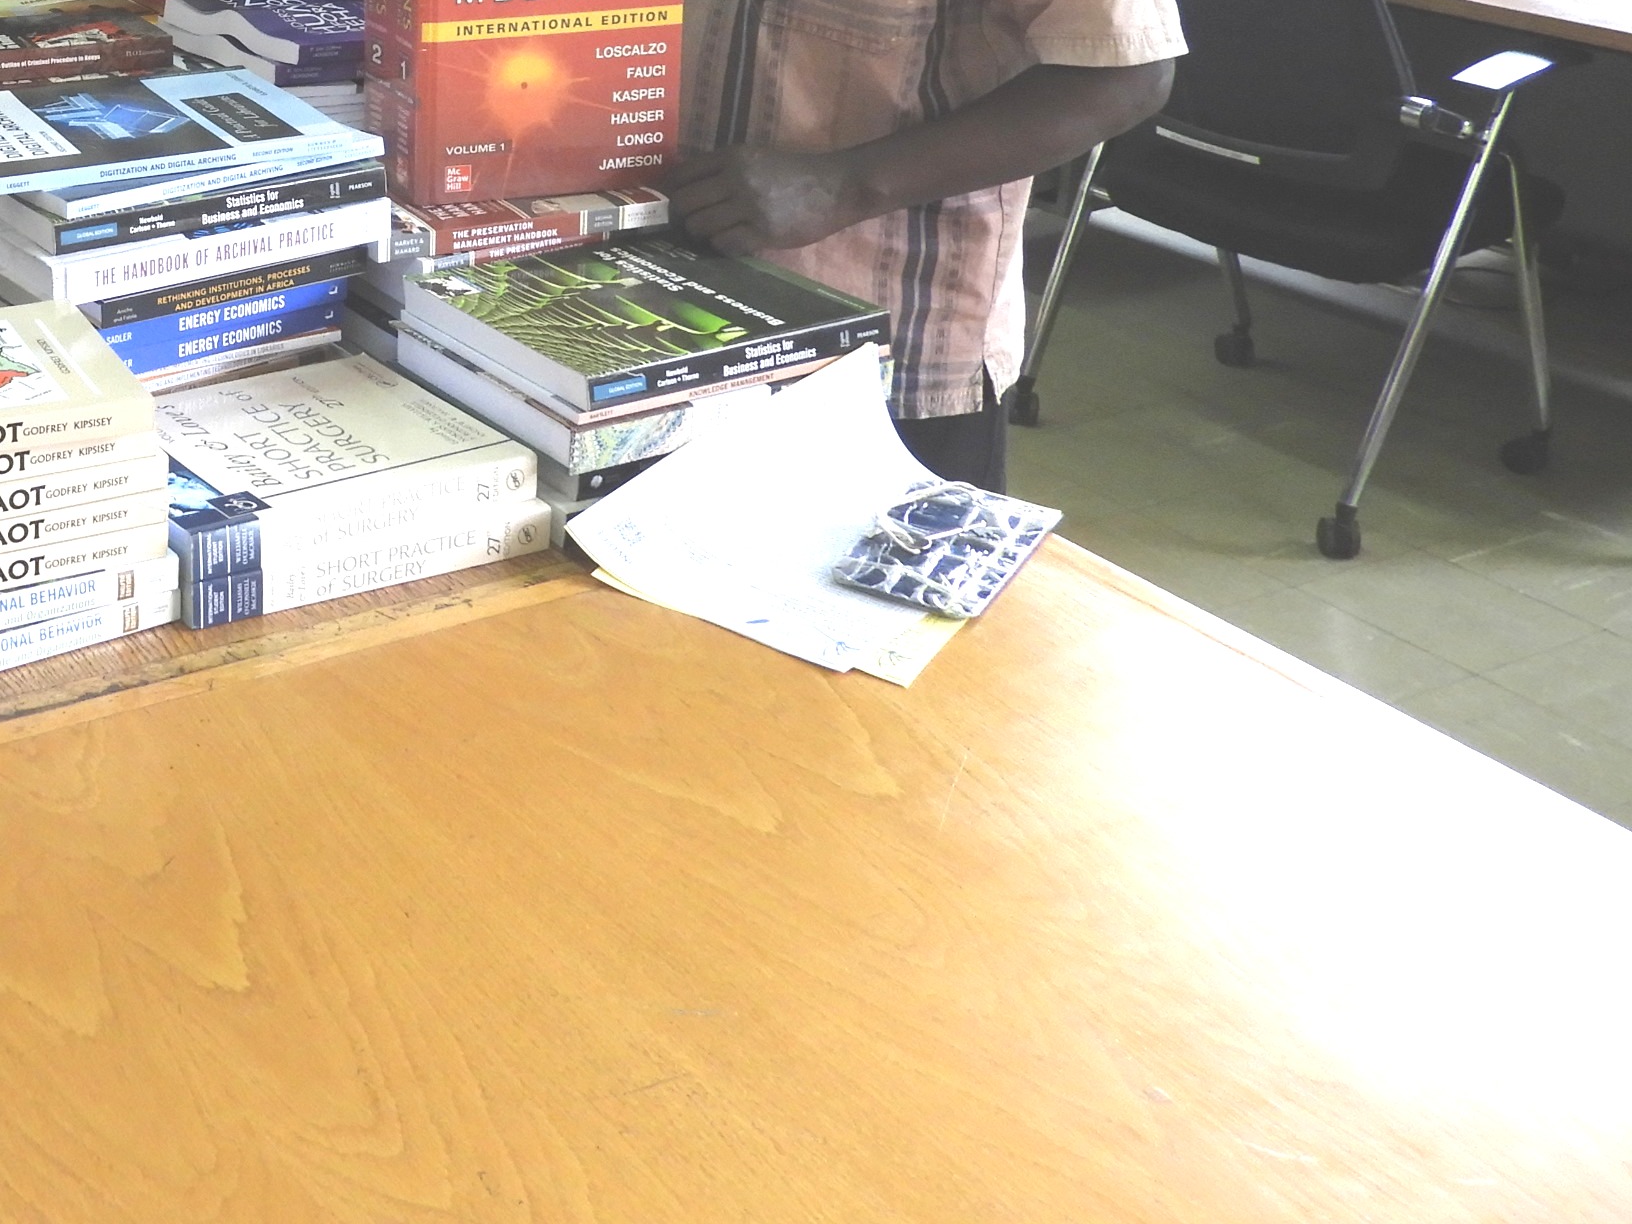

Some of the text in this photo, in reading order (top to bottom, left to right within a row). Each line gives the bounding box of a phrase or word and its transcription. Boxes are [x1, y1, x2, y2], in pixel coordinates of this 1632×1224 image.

[457, 10, 668, 36] INTERNATIONAL EDITION
[372, 44, 382, 64] 2
[596, 42, 667, 58] LOSCALZO
[1, 60, 20, 69] Outline
[28, 58, 50, 67] Criminal
[51, 56, 77, 65] Procedure
[84, 54, 100, 62] Kenya
[400, 61, 406, 79] 1
[627, 65, 666, 79] FAUCI
[612, 87, 665, 102] KASPER
[611, 110, 664, 125] HAUSER
[16, 132, 49, 155] DIGITAL
[446, 142, 505, 155] VOLUME 1
[617, 132, 664, 147] LONGO
[6, 181, 30, 189] LEGGETT
[100, 165, 148, 177] DIGITIZATION
[168, 160, 195, 168] DIGITAL
[198, 154, 236, 165] ARCHIVING
[253, 149, 272, 157] SECOND
[274, 147, 293, 155] EDITION
[447, 167, 462, 176] Mc
[599, 154, 663, 171] JAMESON
[163, 182, 205, 195] DIGITIZATION
[208, 177, 221, 186] AND
[223, 172, 246, 184] DIGITAL
[250, 164, 283, 178] ARCHIVING
[349, 182, 372, 191] PEARSON
[446, 174, 469, 184] Graw
[446, 182, 462, 191] Hill
[226, 189, 279, 208] Statistics for
[202, 198, 304, 225] Business and Economics
[453, 221, 533, 238] THE PRESERVATION
[453, 228, 558, 249] MANAGEMENT HANDBOOK
[95, 223, 334, 286] THE HANDBOOK OF ARCHIVAL PRACTICE
[489, 238, 562, 258] THE PRESERVATION
[593, 251, 616, 261] for
[609, 247, 687, 282] Economics
[615, 259, 684, 292] Statistics
[157, 286, 207, 305] RETHINKING
[209, 276, 264, 293] INSTITUTIONS,
[267, 265, 311, 281] PROCESSES
[175, 279, 295, 311] AND DEVELOPMENT IN AFRICA
[683, 281, 716, 295] and
[179, 295, 286, 331] ENERGY ECONOMICS
[715, 294, 786, 326] Business
[106, 331, 132, 344] SADLER
[178, 320, 282, 358] ENERGY ECONOMICS
[745, 339, 794, 359] Statistics for
[724, 346, 816, 377] Business and Economics
[219, 390, 252, 402] of
[689, 382, 728, 398] KNOWLEDGE
[730, 373, 774, 389] MANAGEMENT
[23, 423, 67, 436] GODFREY
[74, 417, 112, 429] KIPSISEY
[241, 403, 356, 472] PRACTICE
[278, 403, 390, 463] SURGERY
[30, 450, 73, 464] GODFREY
[79, 443, 115, 456] KIPSISEY
[233, 432, 323, 480] SHORT
[46, 484, 87, 499] GODFREY
[94, 476, 129, 490] KIPSISEY
[45, 518, 87, 533] GODFREY
[93, 510, 128, 524] KIPSISEY
[45, 555, 87, 569] GODFREY
[93, 546, 128, 560] KIPSISEY
[317, 530, 476, 578] SHORT PRACTICE
[316, 560, 426, 596] of SURGERY
[30, 579, 96, 605] BEHAVIOR
[39, 616, 102, 641] BEHAVIOR
